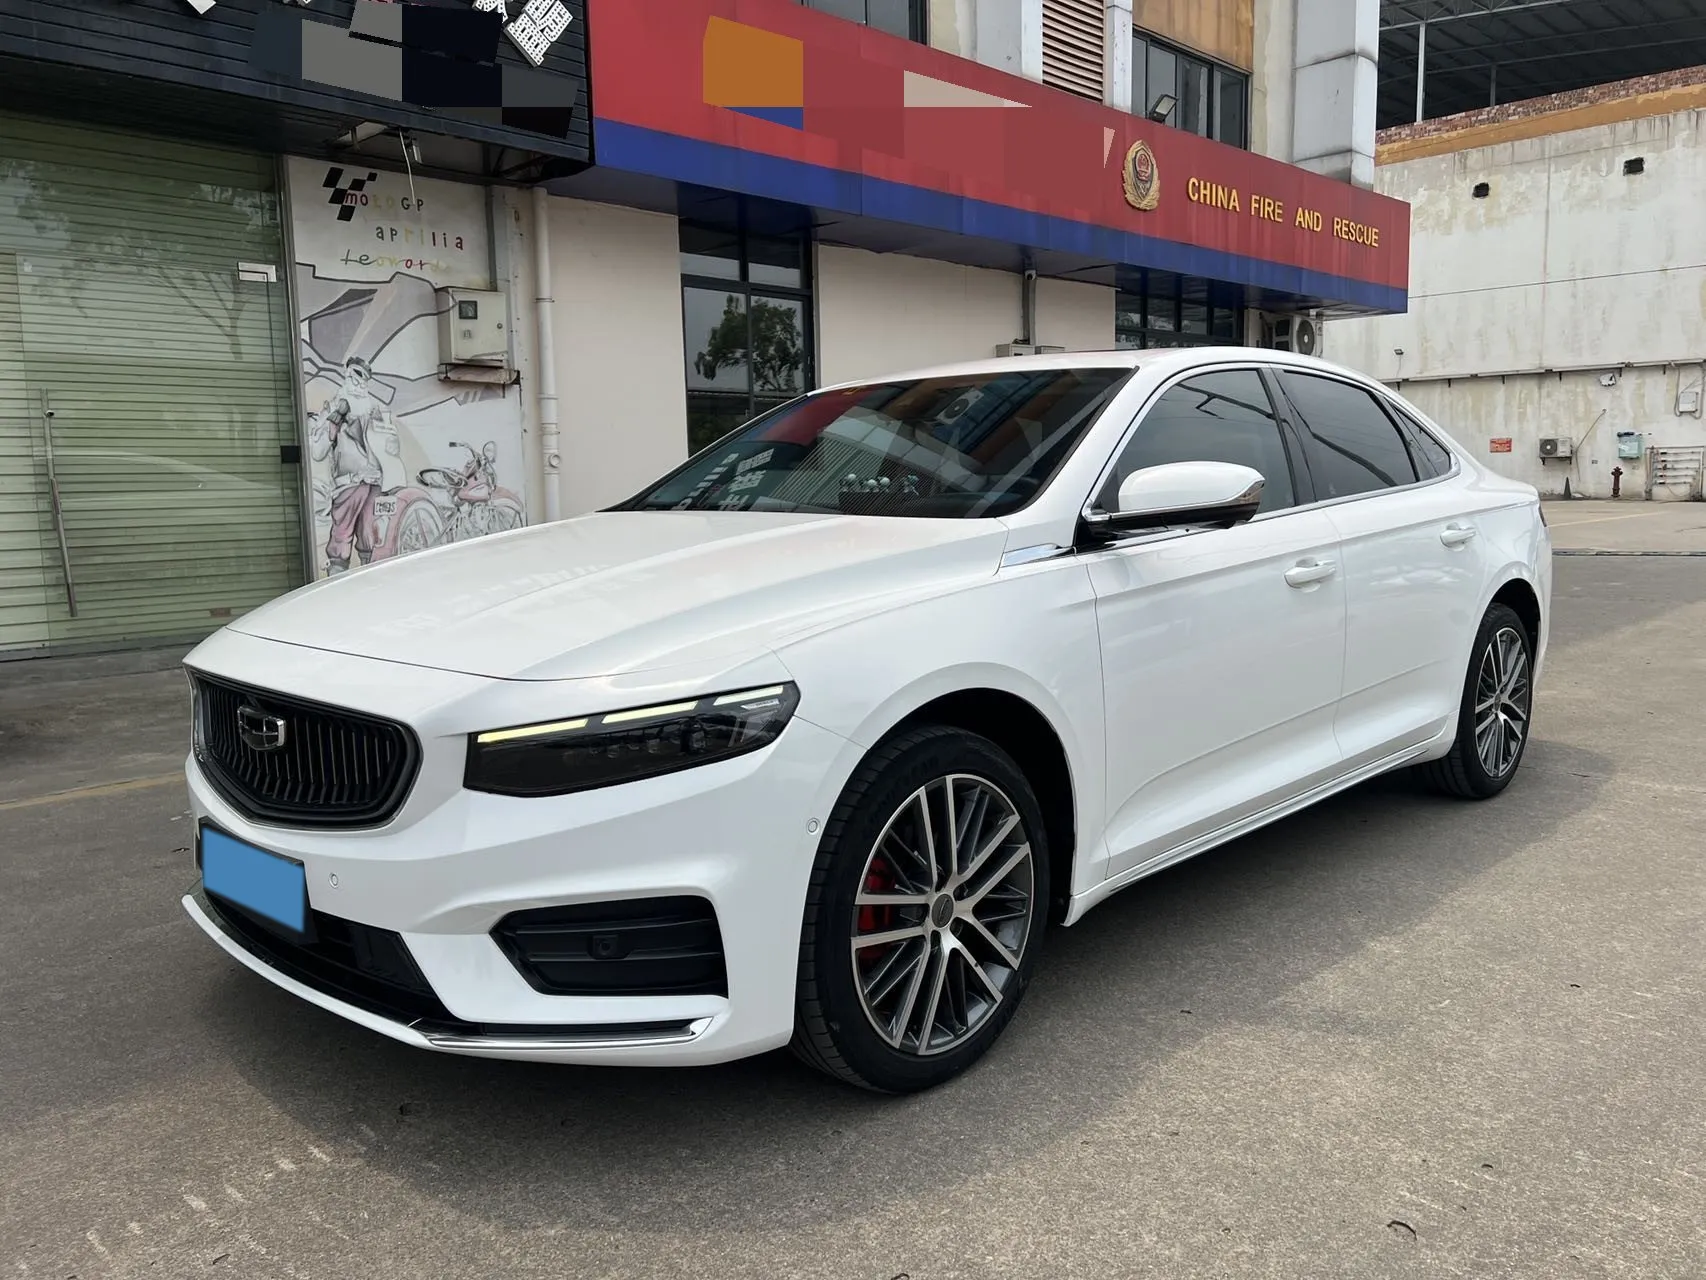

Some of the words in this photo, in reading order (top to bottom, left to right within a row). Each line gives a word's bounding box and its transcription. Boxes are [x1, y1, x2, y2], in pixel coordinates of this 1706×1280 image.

[1188, 177, 1240, 212] CHINA
[1250, 195, 1284, 222] FIRE
[1295, 207, 1322, 232] AND
[1333, 217, 1379, 248] RESCUE
